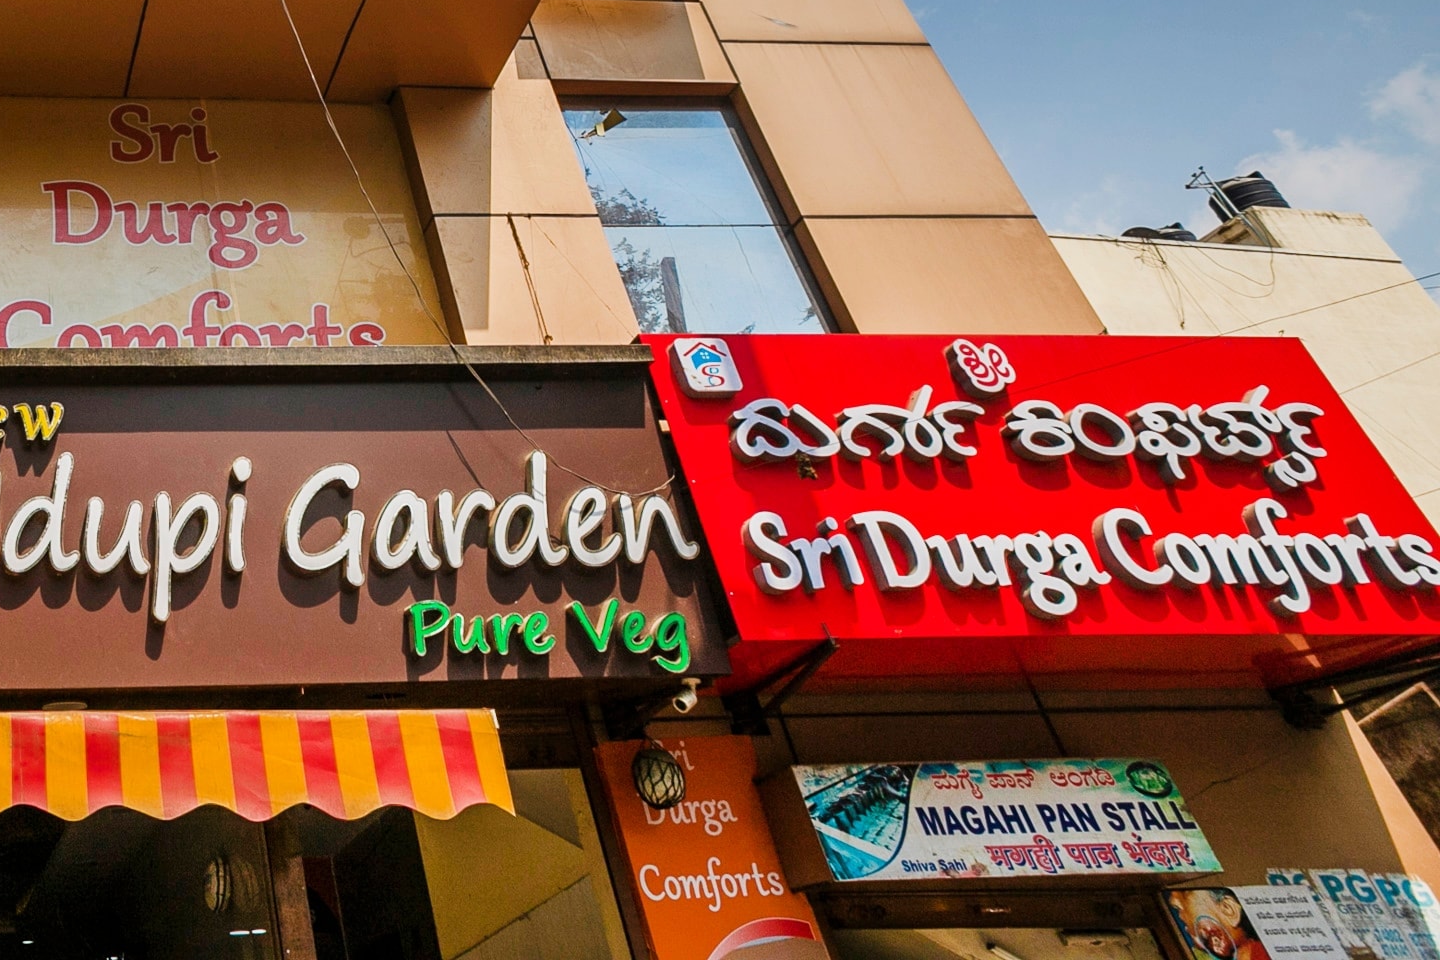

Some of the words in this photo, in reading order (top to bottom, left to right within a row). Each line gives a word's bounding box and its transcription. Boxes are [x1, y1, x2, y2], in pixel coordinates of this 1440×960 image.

[108, 103, 220, 165] Sri
[41, 180, 306, 270] Durga
[956, 342, 1013, 389] ಶ್ರೀ
[734, 384, 986, 459] ದುರ್ಗಾ
[284, 449, 700, 587] Garden
[745, 510, 865, 591] Sri
[853, 510, 1112, 616] Durga
[1095, 497, 1440, 614] Comforts
[406, 598, 557, 657] Pure
[565, 597, 691, 674] Veg
[658, 740, 695, 772] ri
[915, 804, 1036, 837] MAGAHI
[1035, 803, 1106, 834] PAN
[1099, 800, 1198, 831] STALL
[901, 859, 937, 874] Shiva
[983, 834, 1065, 874] मगही
[1062, 843, 1124, 869] पान
[639, 856, 785, 913] Comforts
[1318, 874, 1377, 904] PG
[1374, 878, 1434, 907] PG
[1337, 903, 1384, 916] GENTS
